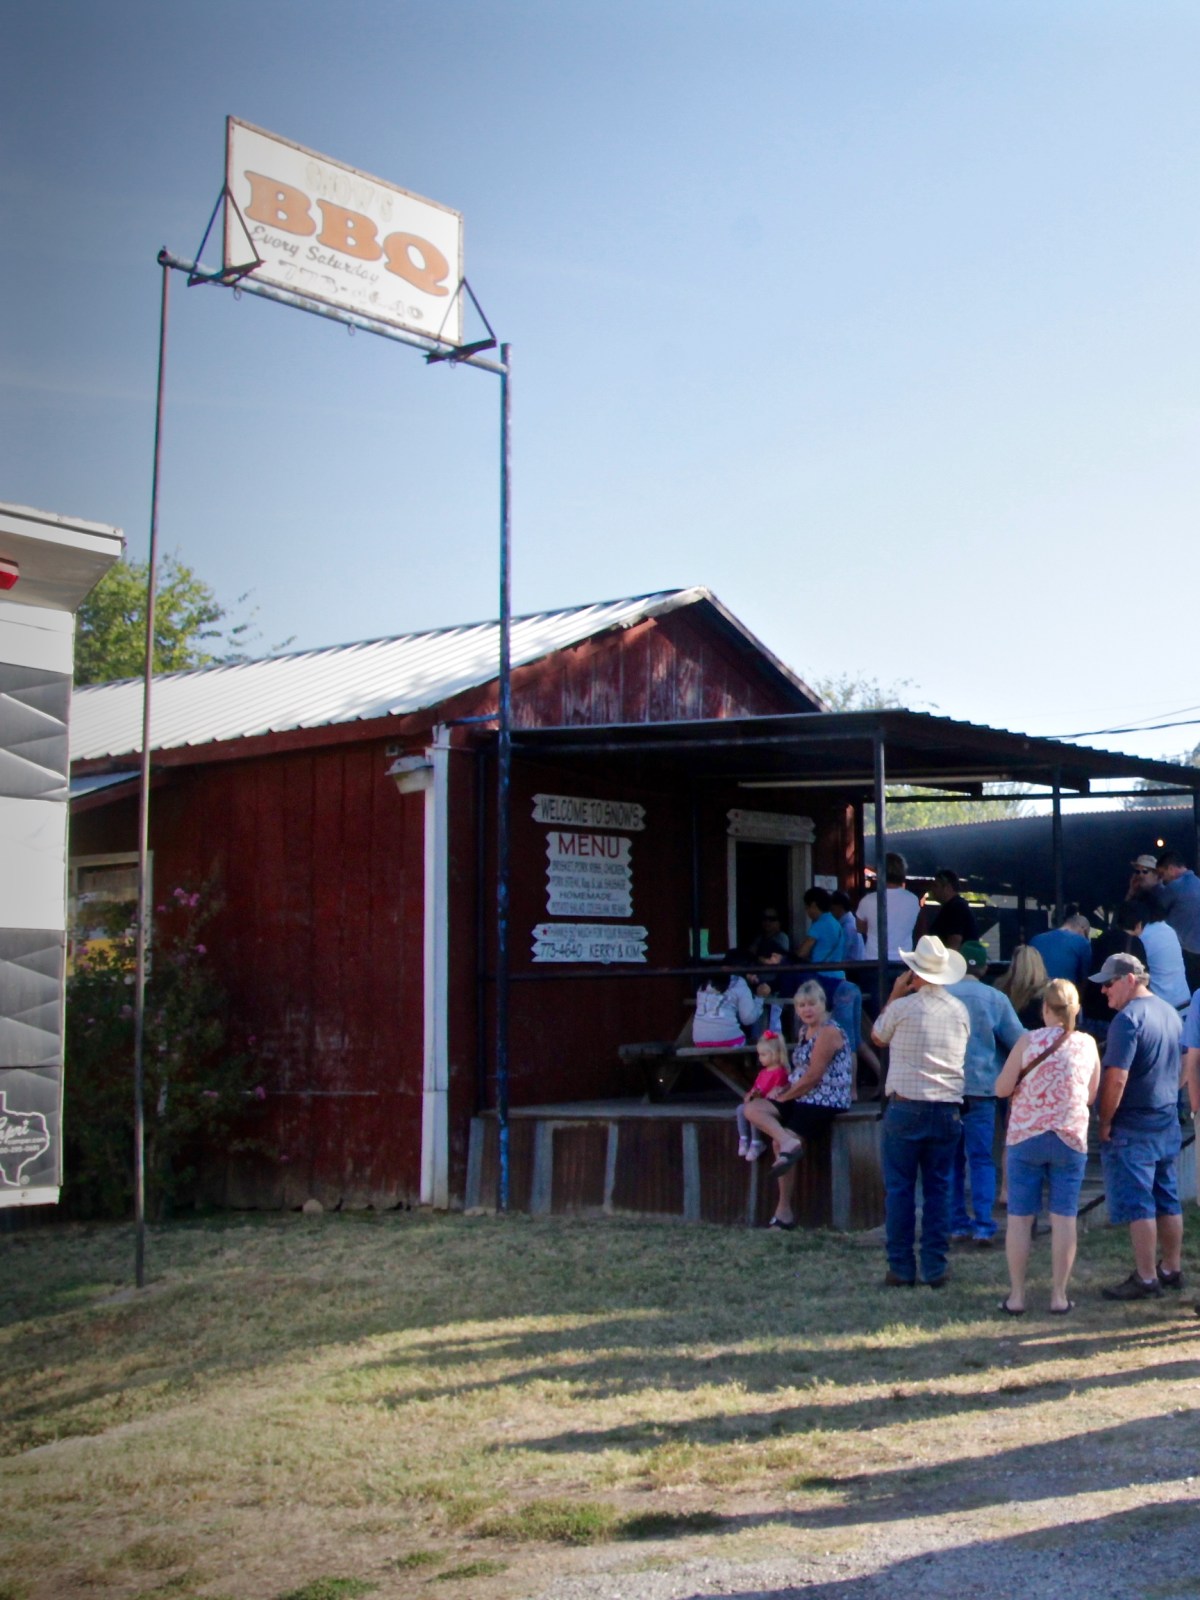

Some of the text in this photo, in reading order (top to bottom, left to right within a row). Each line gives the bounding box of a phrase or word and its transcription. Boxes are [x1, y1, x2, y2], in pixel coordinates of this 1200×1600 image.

[243, 169, 451, 297] BBQ
[249, 225, 380, 285] Every Saturday
[541, 798, 640, 828] WELCOME TO SNOW'S
[558, 833, 620, 858] MENU
[540, 942, 583, 958] 773-4640
[589, 943, 616, 958] KERRY
[625, 943, 640, 958] KIM
